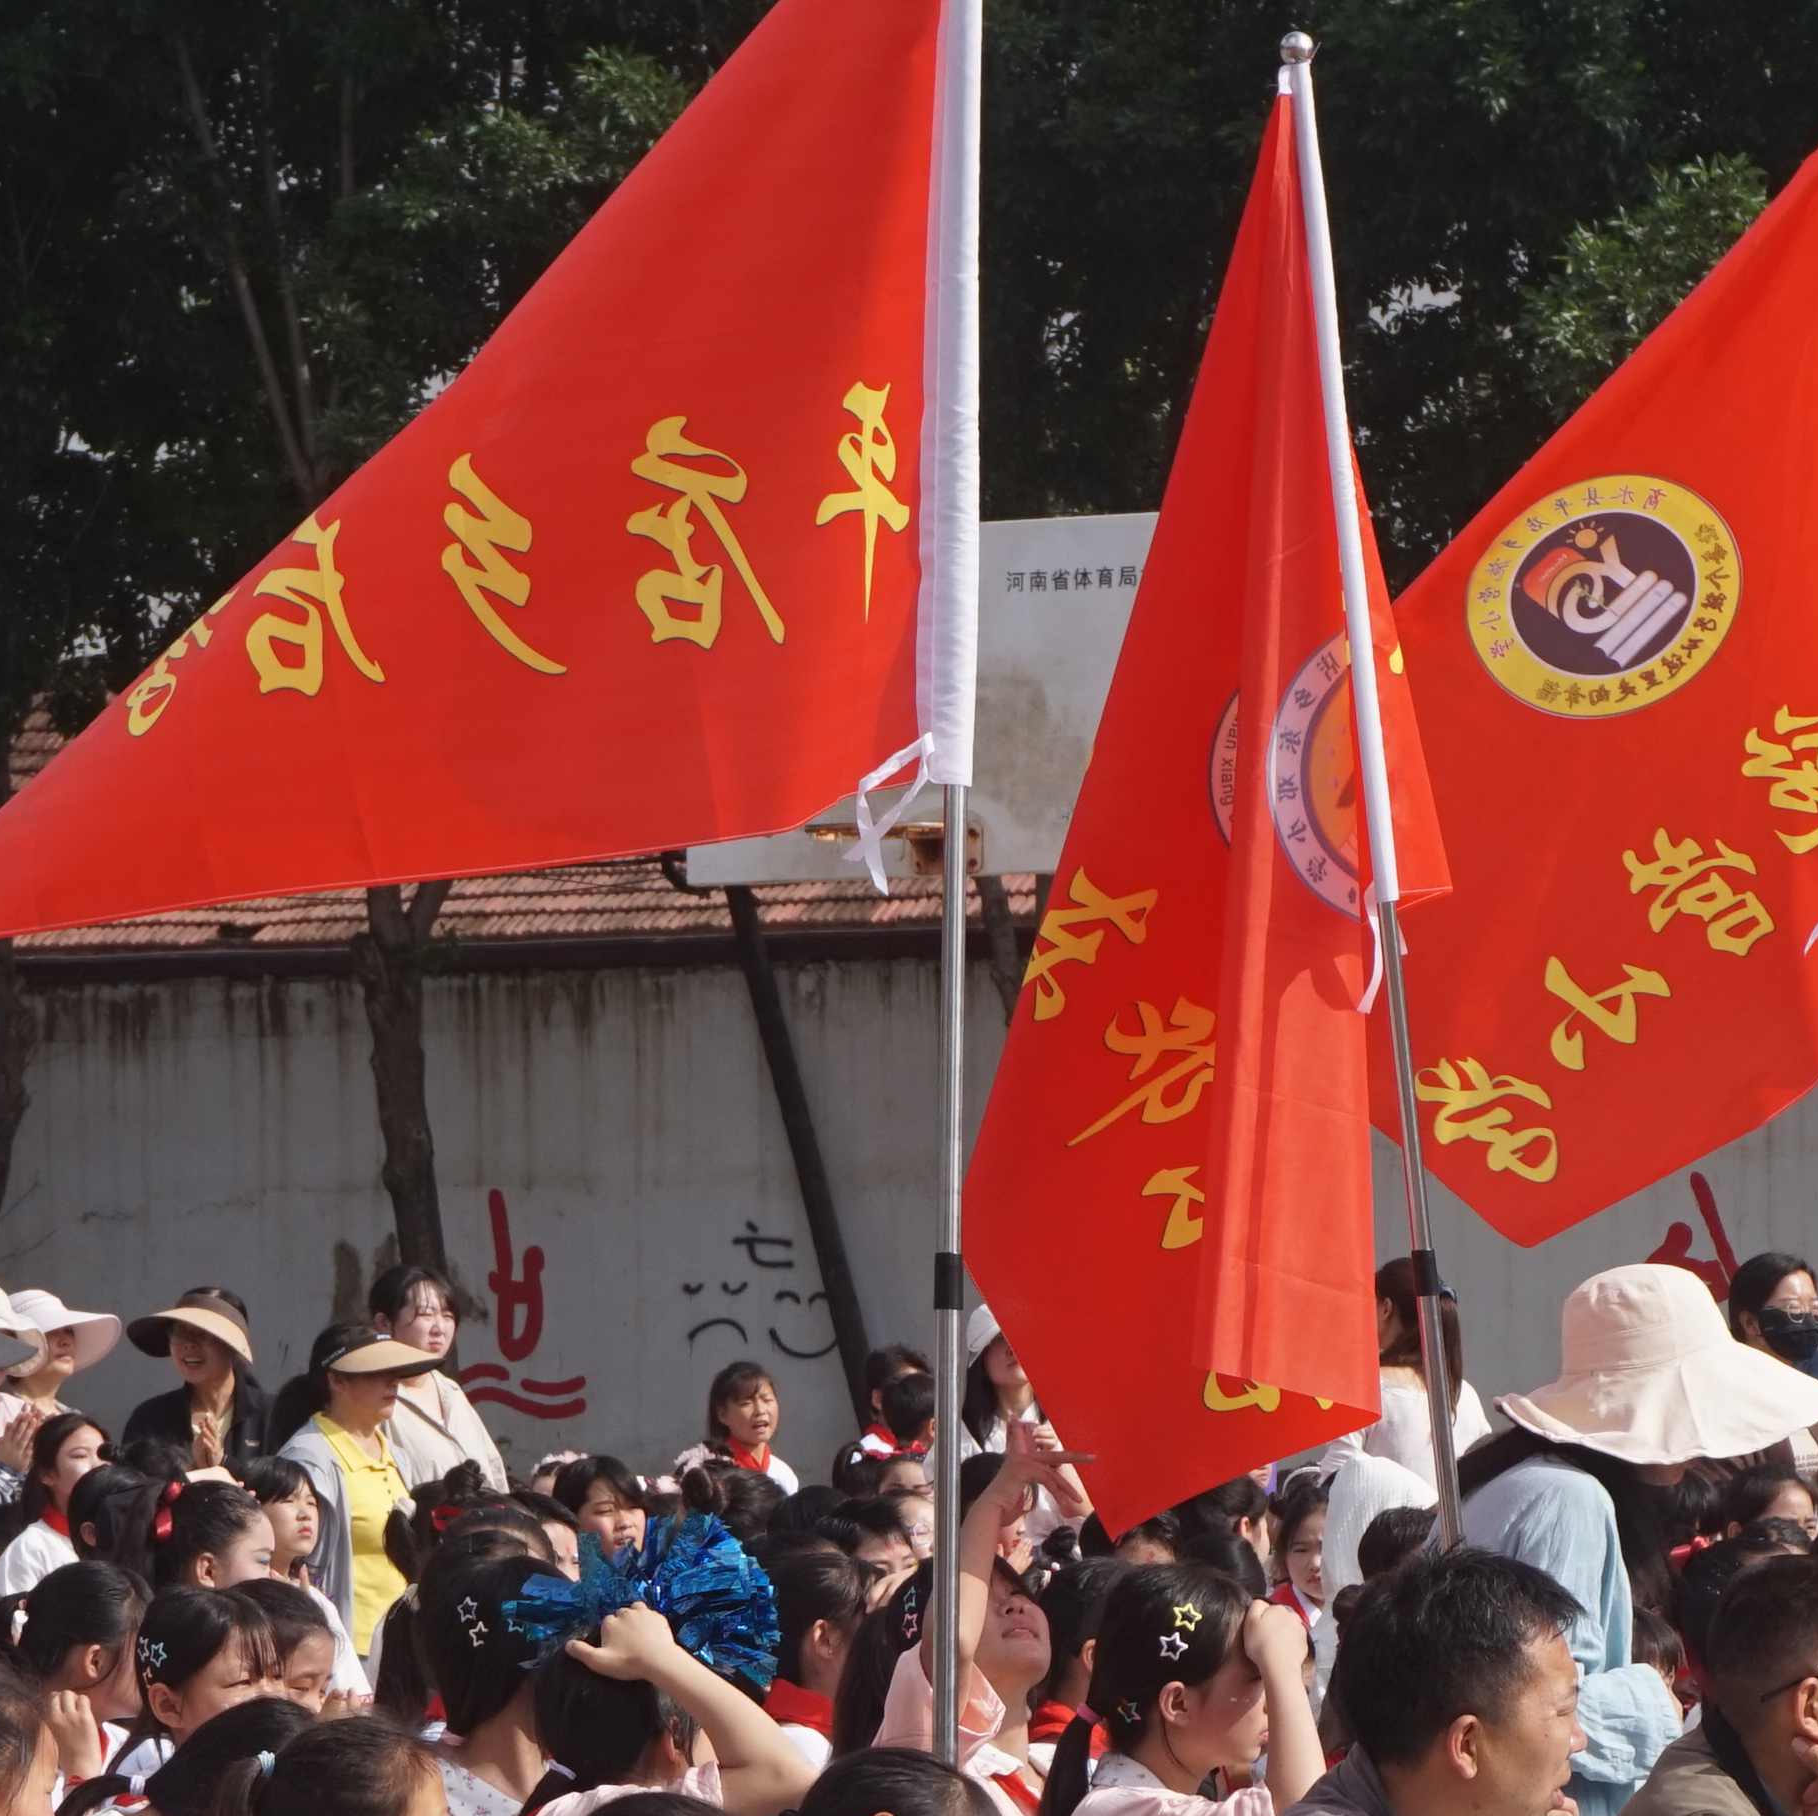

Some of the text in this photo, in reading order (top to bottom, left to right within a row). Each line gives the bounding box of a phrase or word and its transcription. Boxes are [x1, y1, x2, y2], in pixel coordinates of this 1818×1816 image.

[1006, 566, 1145, 593] 河南省体育局
